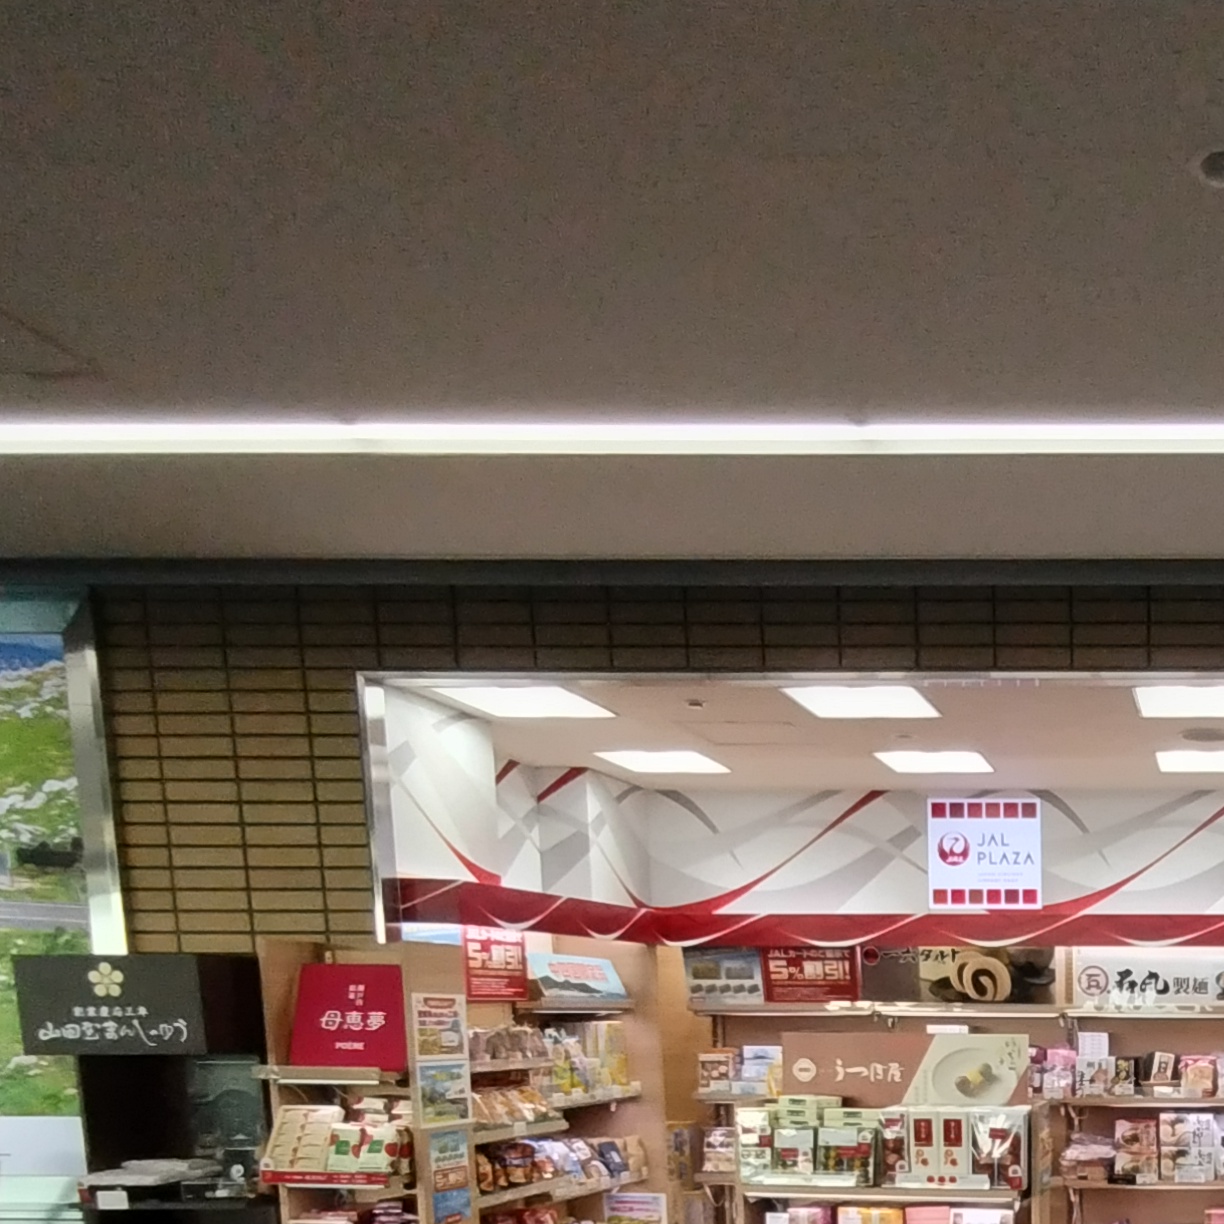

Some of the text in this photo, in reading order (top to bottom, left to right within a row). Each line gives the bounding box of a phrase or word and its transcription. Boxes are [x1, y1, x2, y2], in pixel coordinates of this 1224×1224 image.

[977, 833, 1010, 847] JAL
[977, 852, 1035, 865] PLAZA
[769, 960, 850, 980] 5%割引!
[320, 1010, 387, 1031] 母恵夢
[834, 1058, 903, 1082] うつぼ屋
